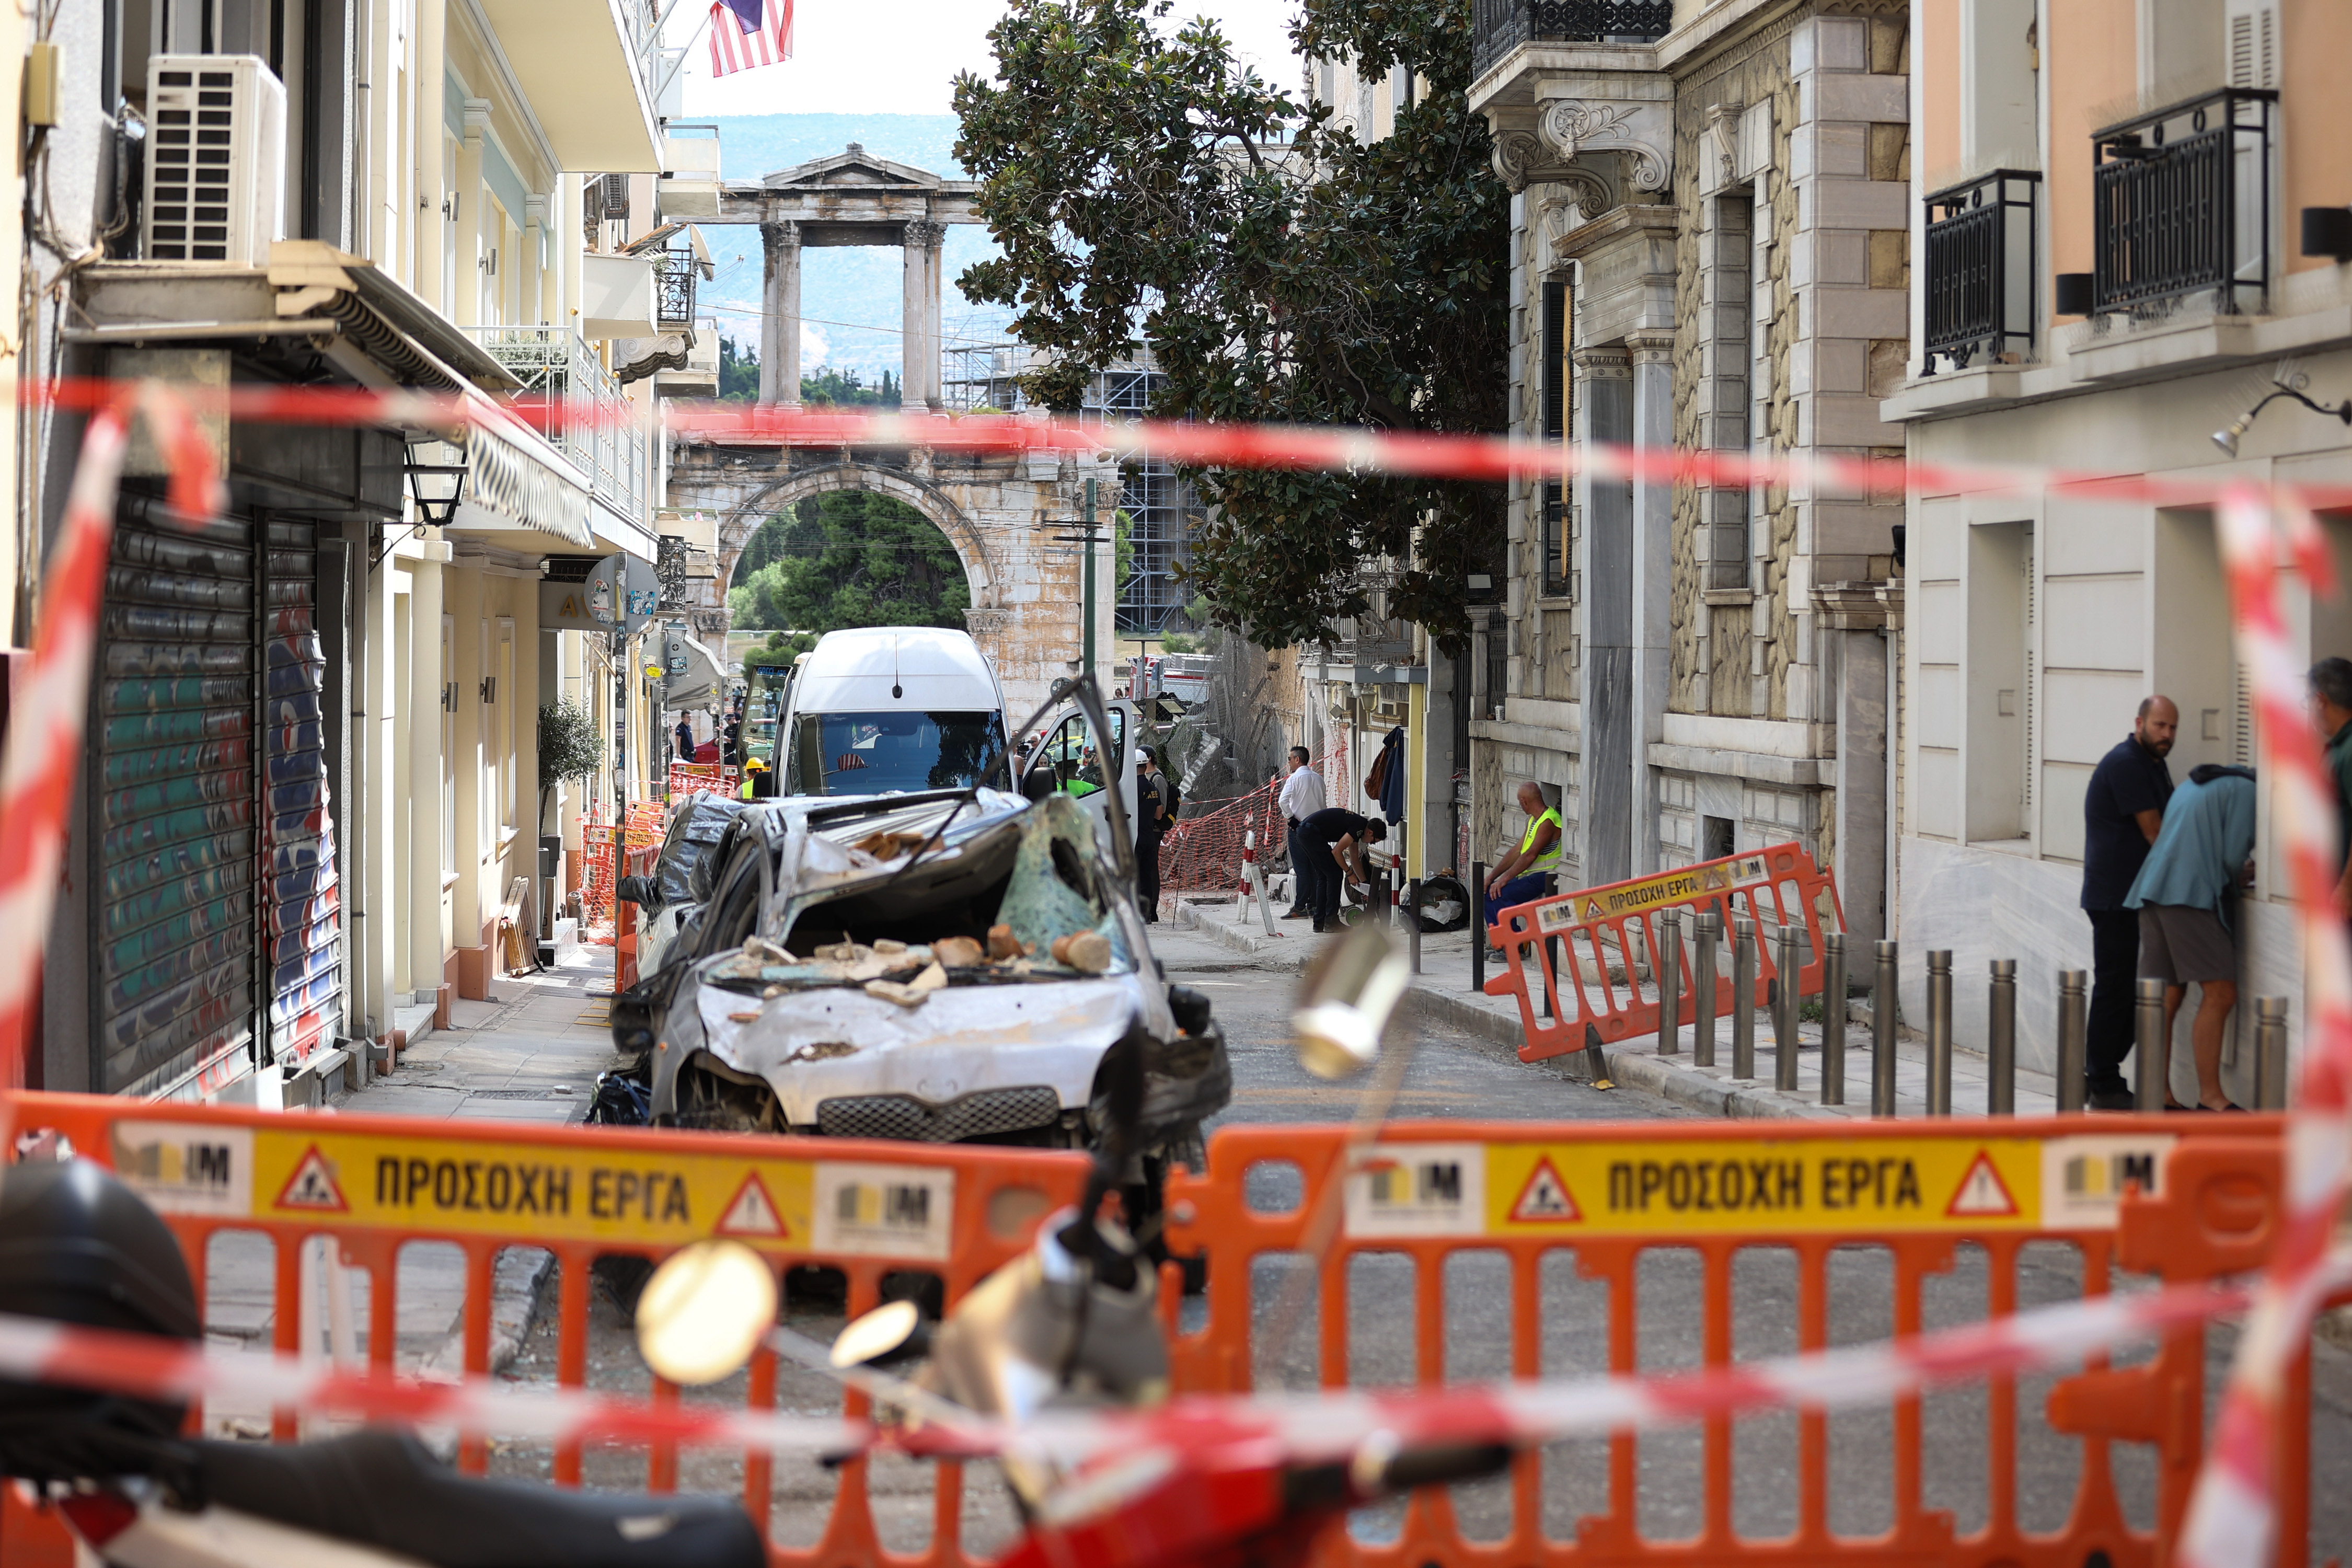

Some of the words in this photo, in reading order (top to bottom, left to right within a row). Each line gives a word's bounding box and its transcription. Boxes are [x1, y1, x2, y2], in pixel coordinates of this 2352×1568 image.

[1609, 884, 1666, 910] ΠΡΟΣΟΧΗ
[1667, 877, 1698, 896] ΕΡΓΑ
[375, 1155, 572, 1217] ΠΡΟΣΟΧΗ
[589, 1167, 690, 1223] ΕΡΓΑ
[1609, 1158, 1803, 1213] ΠΡΟΣΟΧΗ
[1821, 1158, 1922, 1210] ΕΡΓΑ
